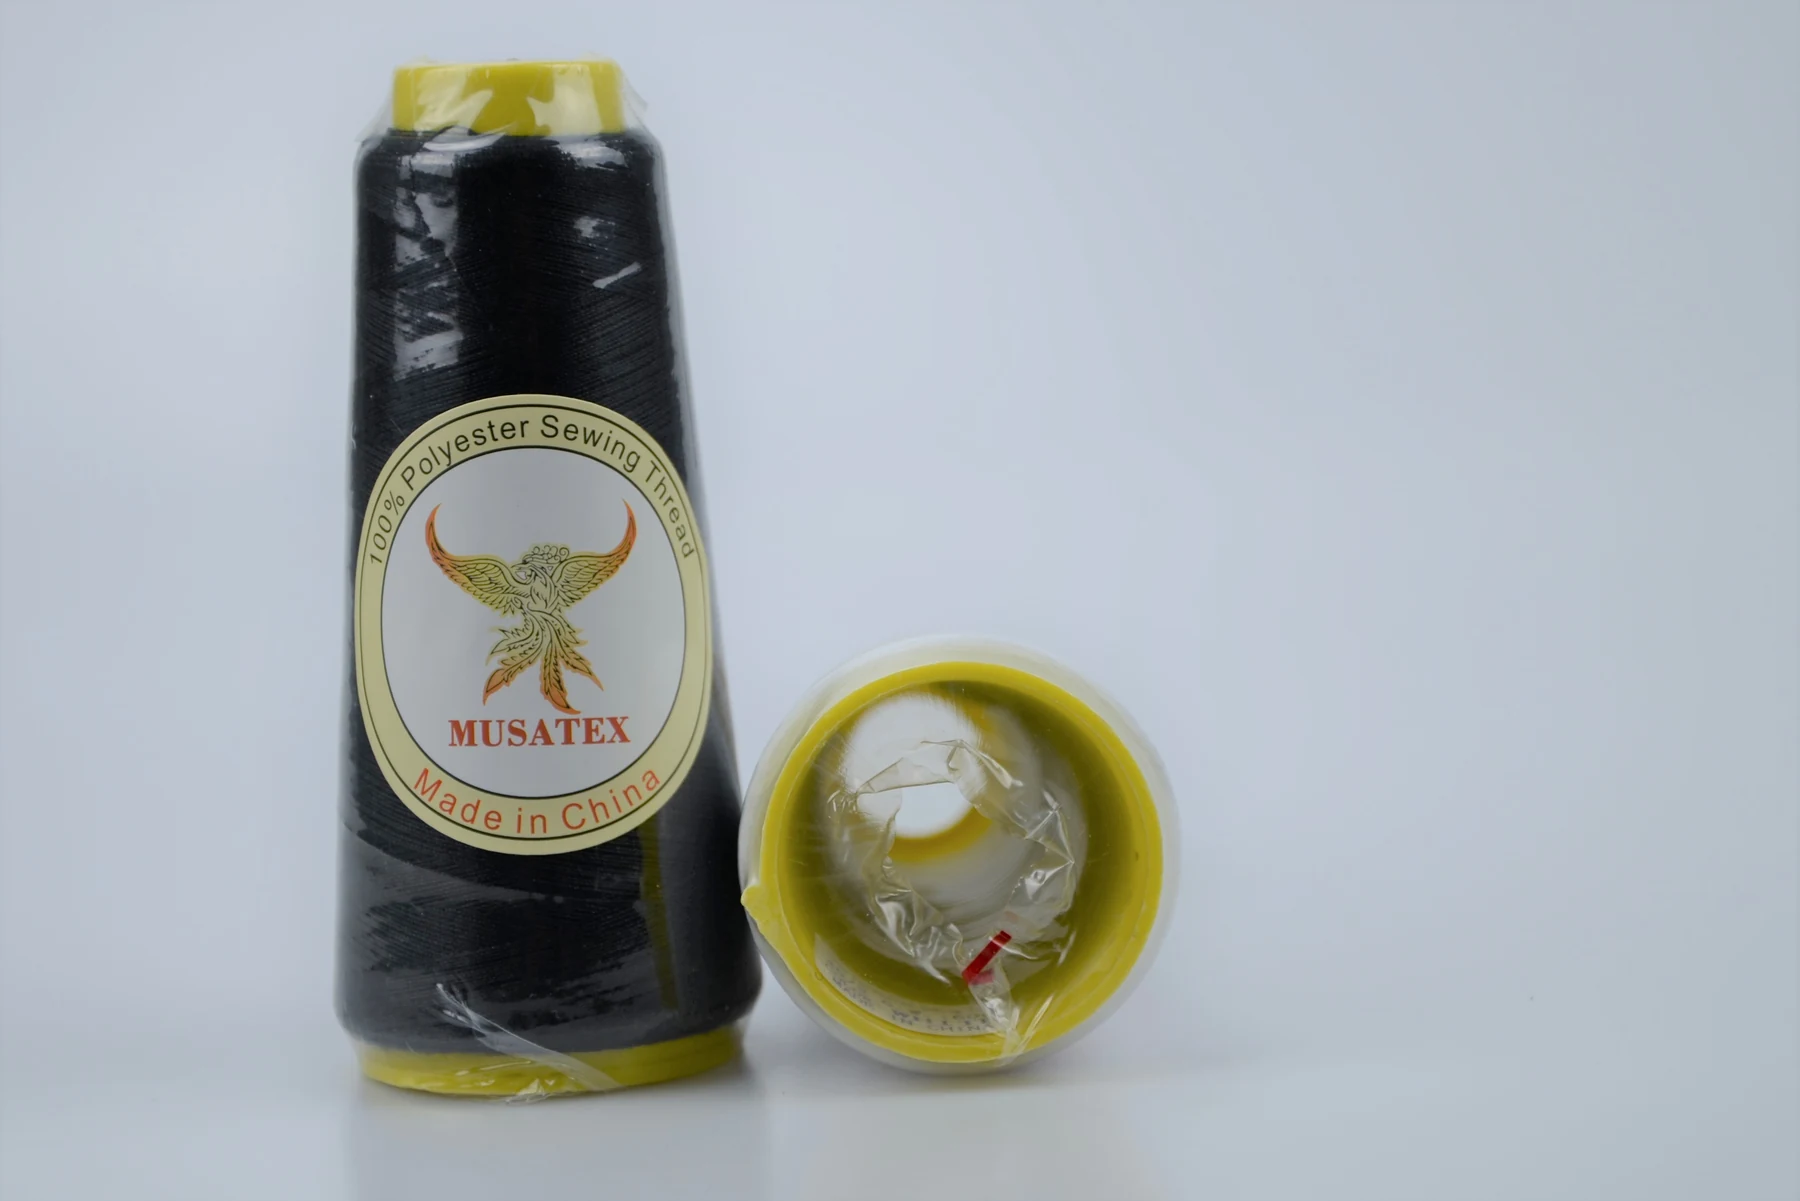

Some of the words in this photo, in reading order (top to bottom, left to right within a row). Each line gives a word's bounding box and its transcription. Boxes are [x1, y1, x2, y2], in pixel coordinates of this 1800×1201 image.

[369, 490, 405, 565] 100%
[400, 418, 530, 490] Polyester
[540, 414, 641, 473] Sewing
[641, 460, 695, 559] Thread
[448, 716, 631, 747] MUSATEX
[413, 767, 502, 830] Made
[516, 808, 547, 834] in
[561, 769, 661, 830] China
